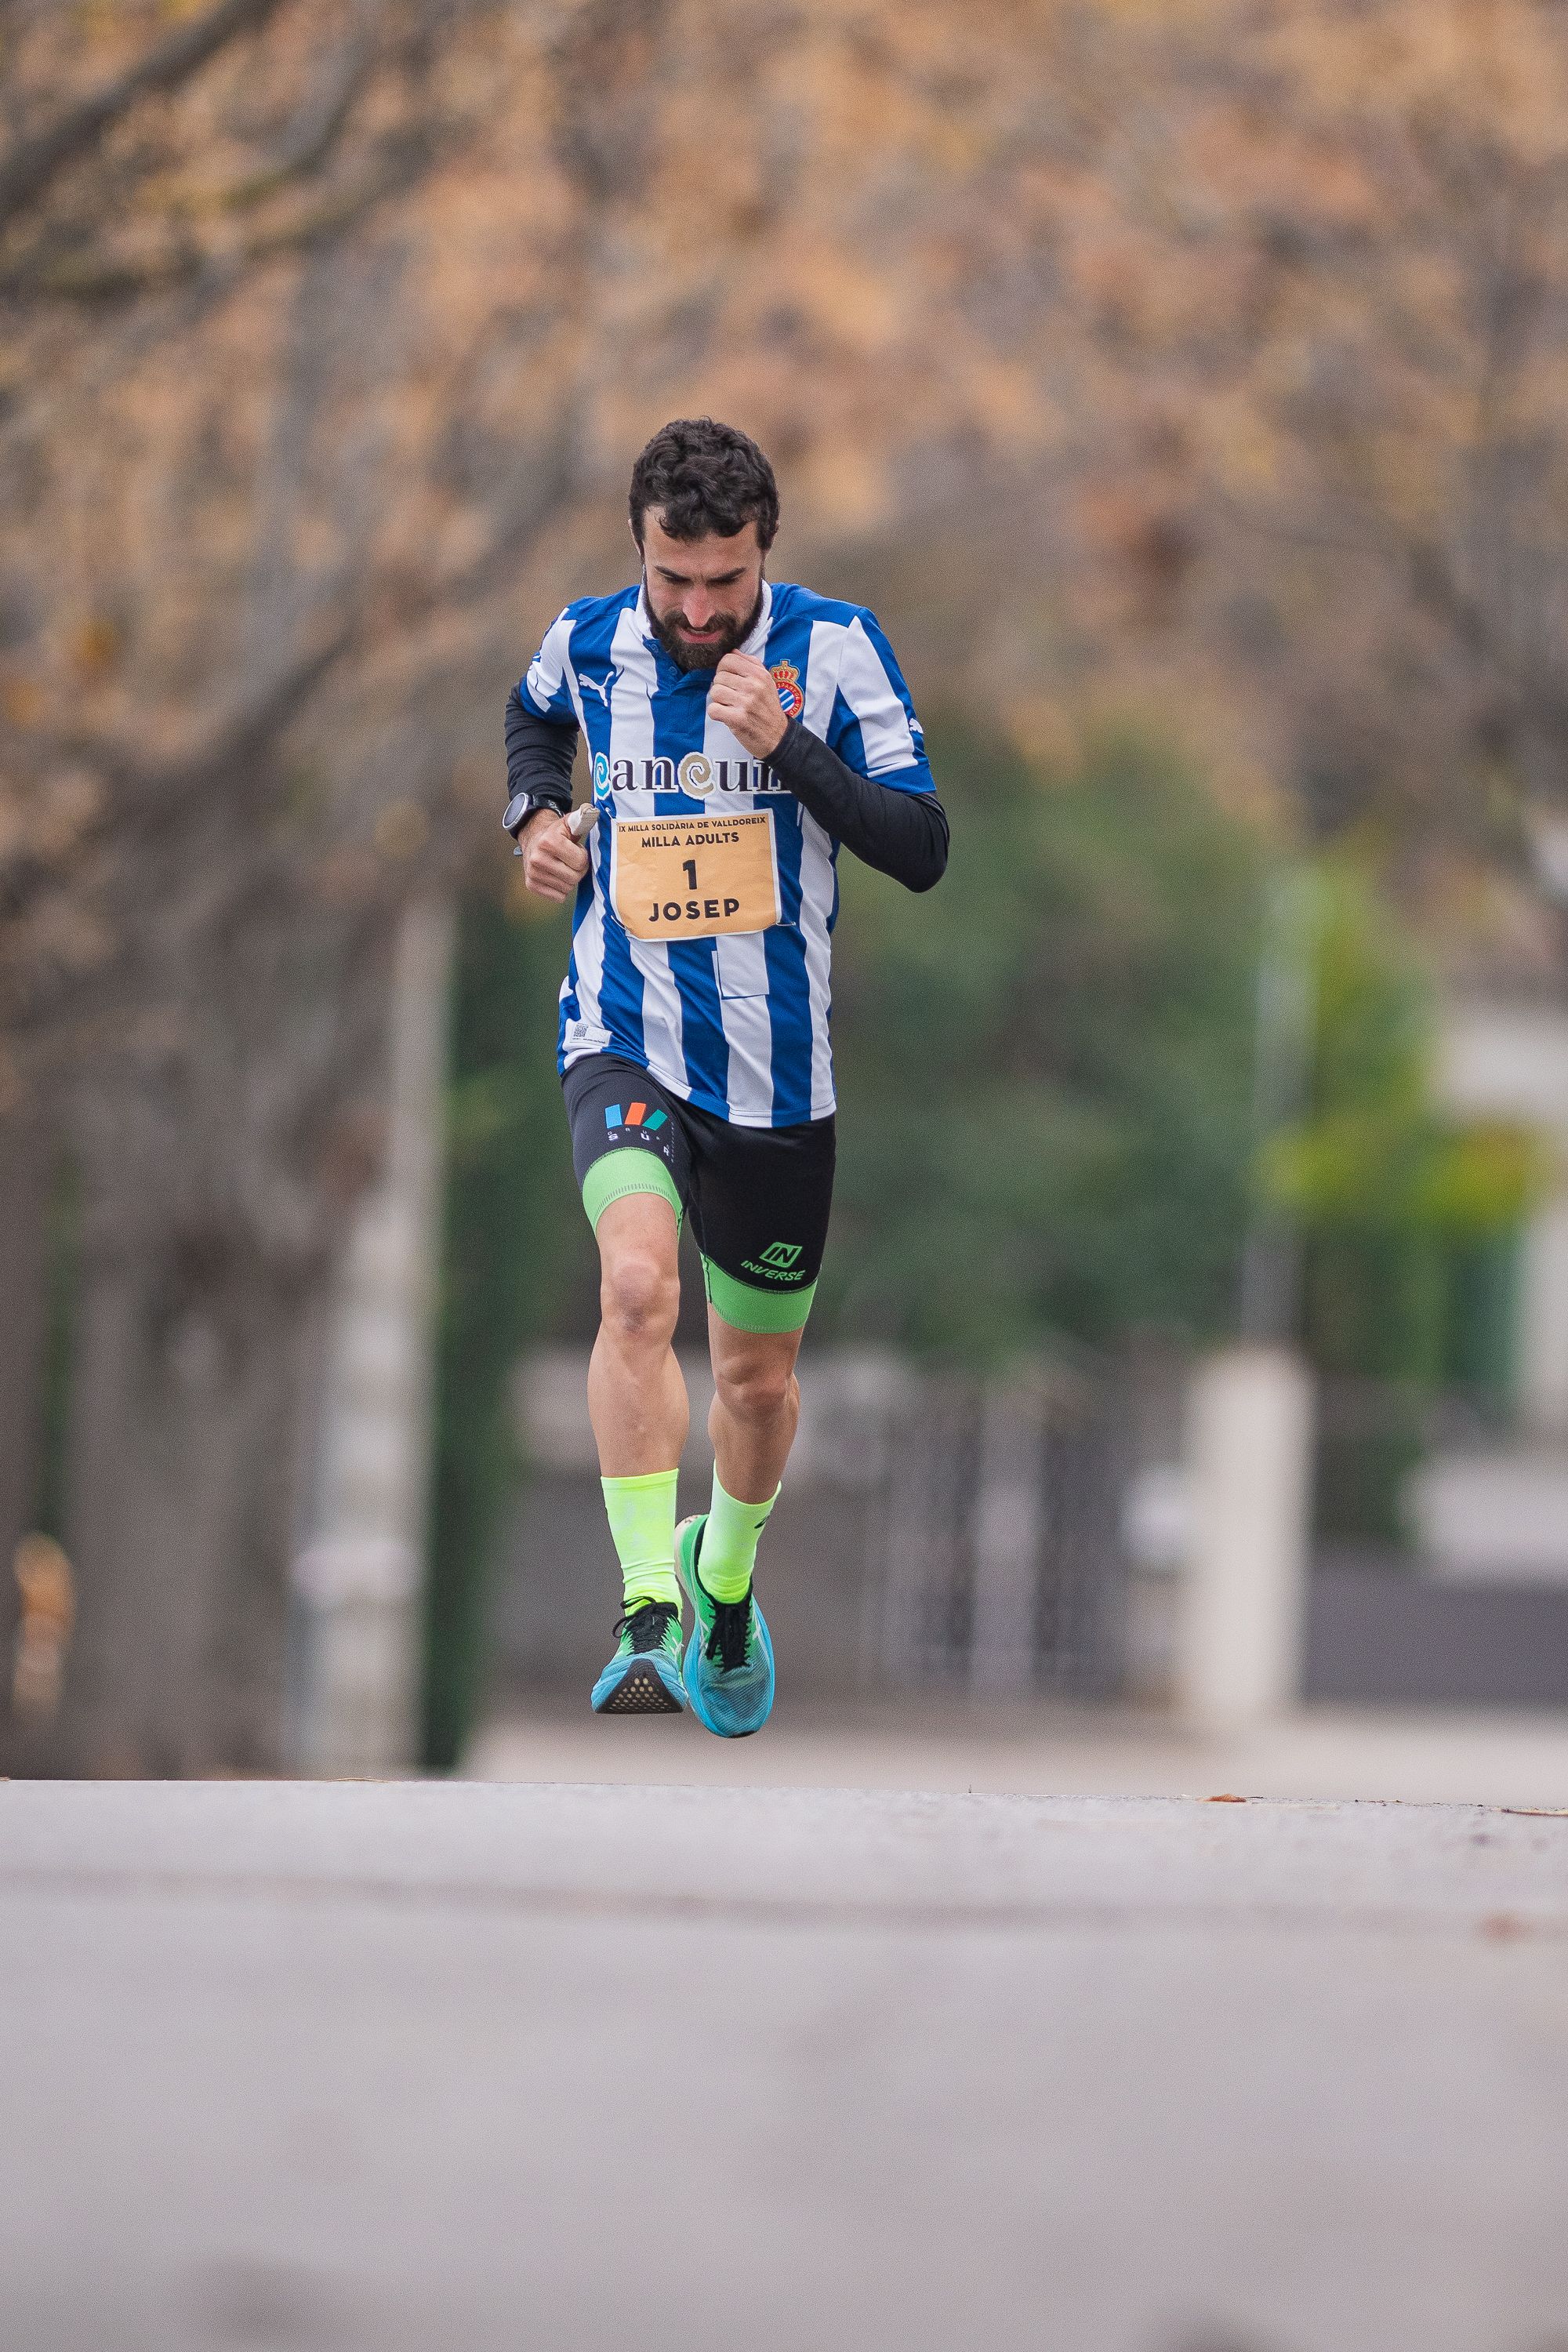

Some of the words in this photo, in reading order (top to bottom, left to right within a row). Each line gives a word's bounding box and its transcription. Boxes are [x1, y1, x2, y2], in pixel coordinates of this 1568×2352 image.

[652, 822, 695, 831] SOLIDÀRIA
[712, 817, 766, 828] VALLDOREIX
[641, 835, 681, 848] MILLA
[685, 832, 739, 845] ADULTS
[682, 859, 698, 890] 1
[648, 898, 739, 922] JOSEP
[741, 1261, 806, 1280] INVERSE
